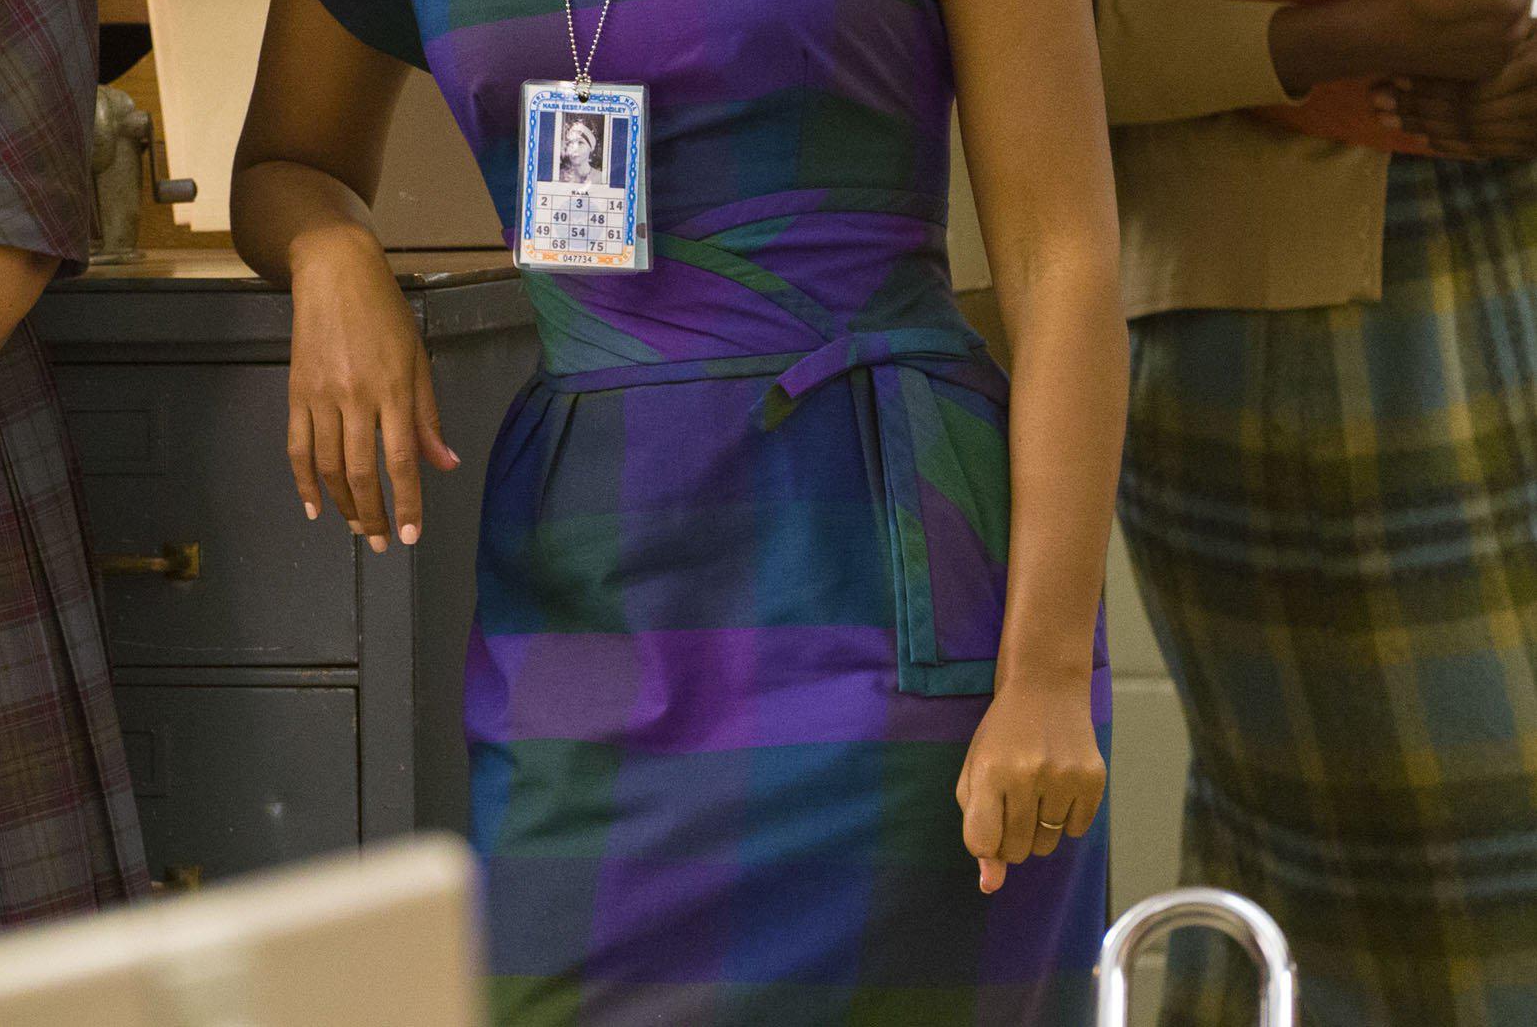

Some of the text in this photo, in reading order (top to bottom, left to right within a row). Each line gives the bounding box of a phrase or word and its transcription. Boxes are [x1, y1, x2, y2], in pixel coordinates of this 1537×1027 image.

[541, 196, 623, 211] 2 3 14
[553, 212, 605, 224] 40 48
[536, 225, 622, 240] 49 54 61
[552, 240, 604, 252] 68 75
[562, 255, 593, 263] 047734
